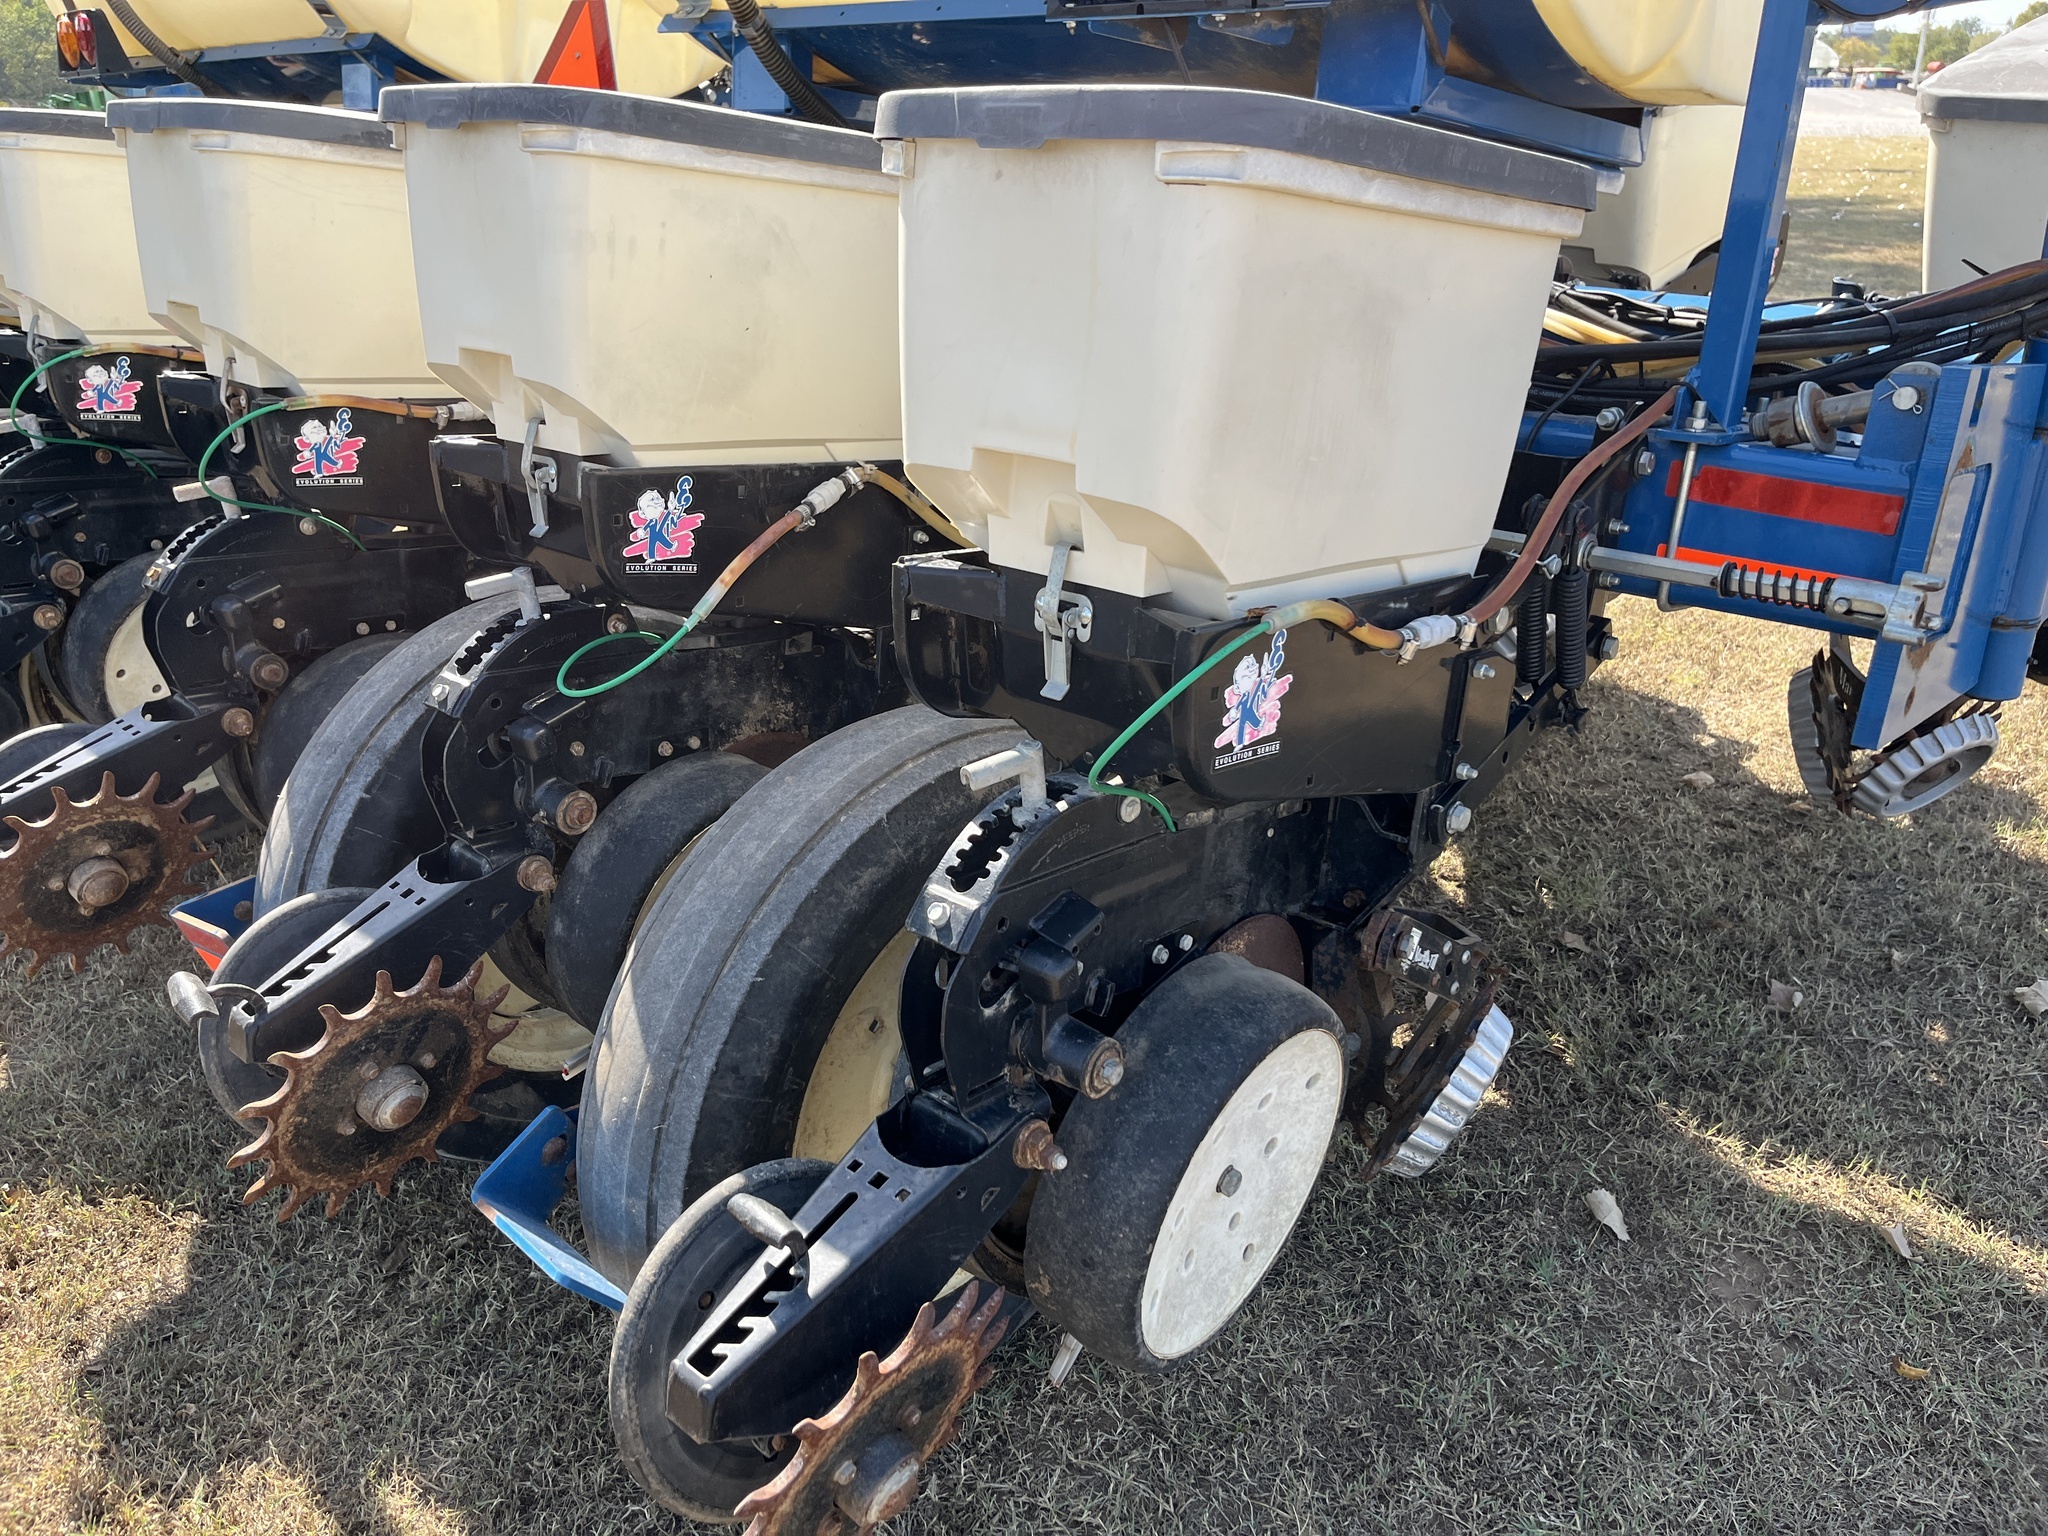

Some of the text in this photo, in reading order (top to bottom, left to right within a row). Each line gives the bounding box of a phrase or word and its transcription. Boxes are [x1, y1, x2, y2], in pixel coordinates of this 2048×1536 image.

[672, 564, 698, 572] SERIES
[1214, 743, 1279, 767] EVOLUTION SERIES
